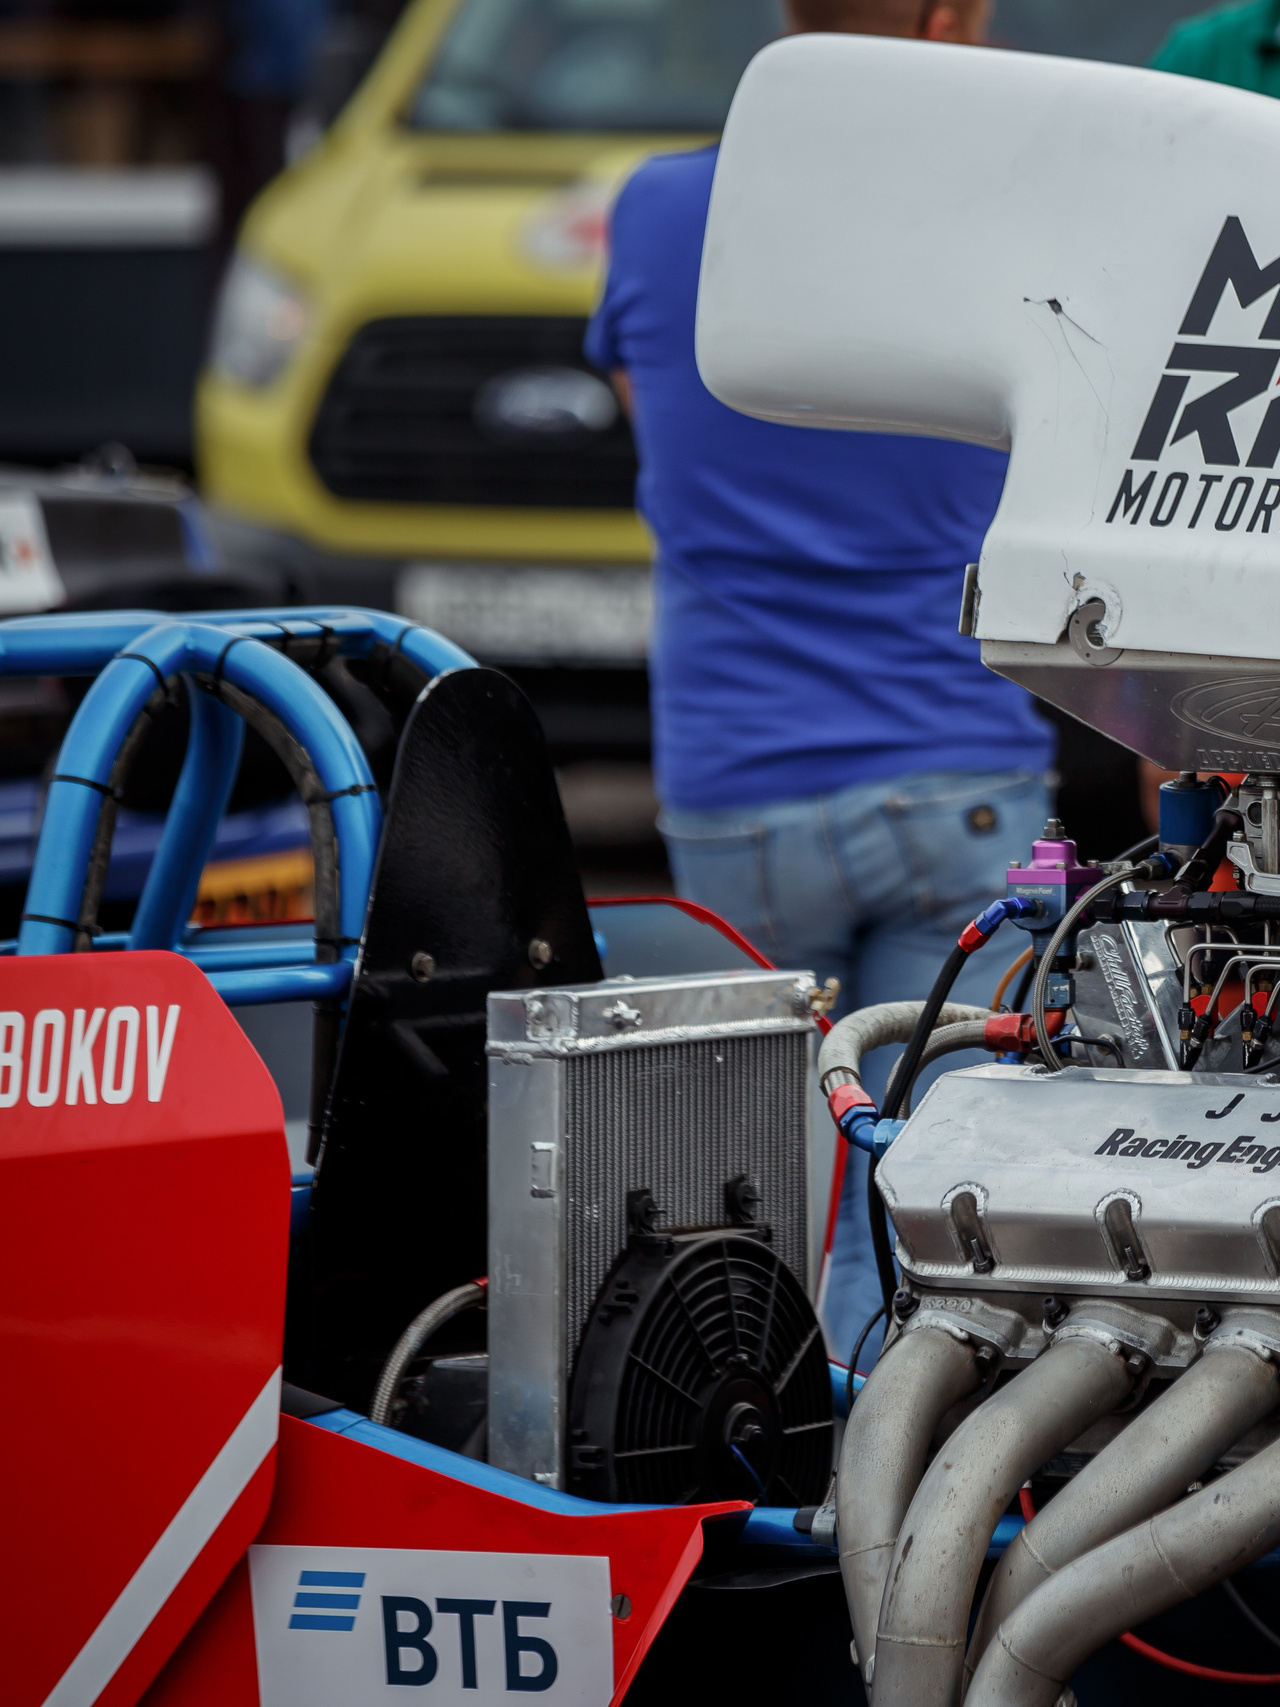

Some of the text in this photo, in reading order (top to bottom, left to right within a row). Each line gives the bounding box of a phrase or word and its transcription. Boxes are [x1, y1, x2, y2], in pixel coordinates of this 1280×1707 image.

[0, 1004, 181, 1109] BOKOV
[1205, 1093, 1245, 1120] J
[1094, 1128, 1225, 1169] Racing
[379, 1594, 559, 1693] ВТБ
